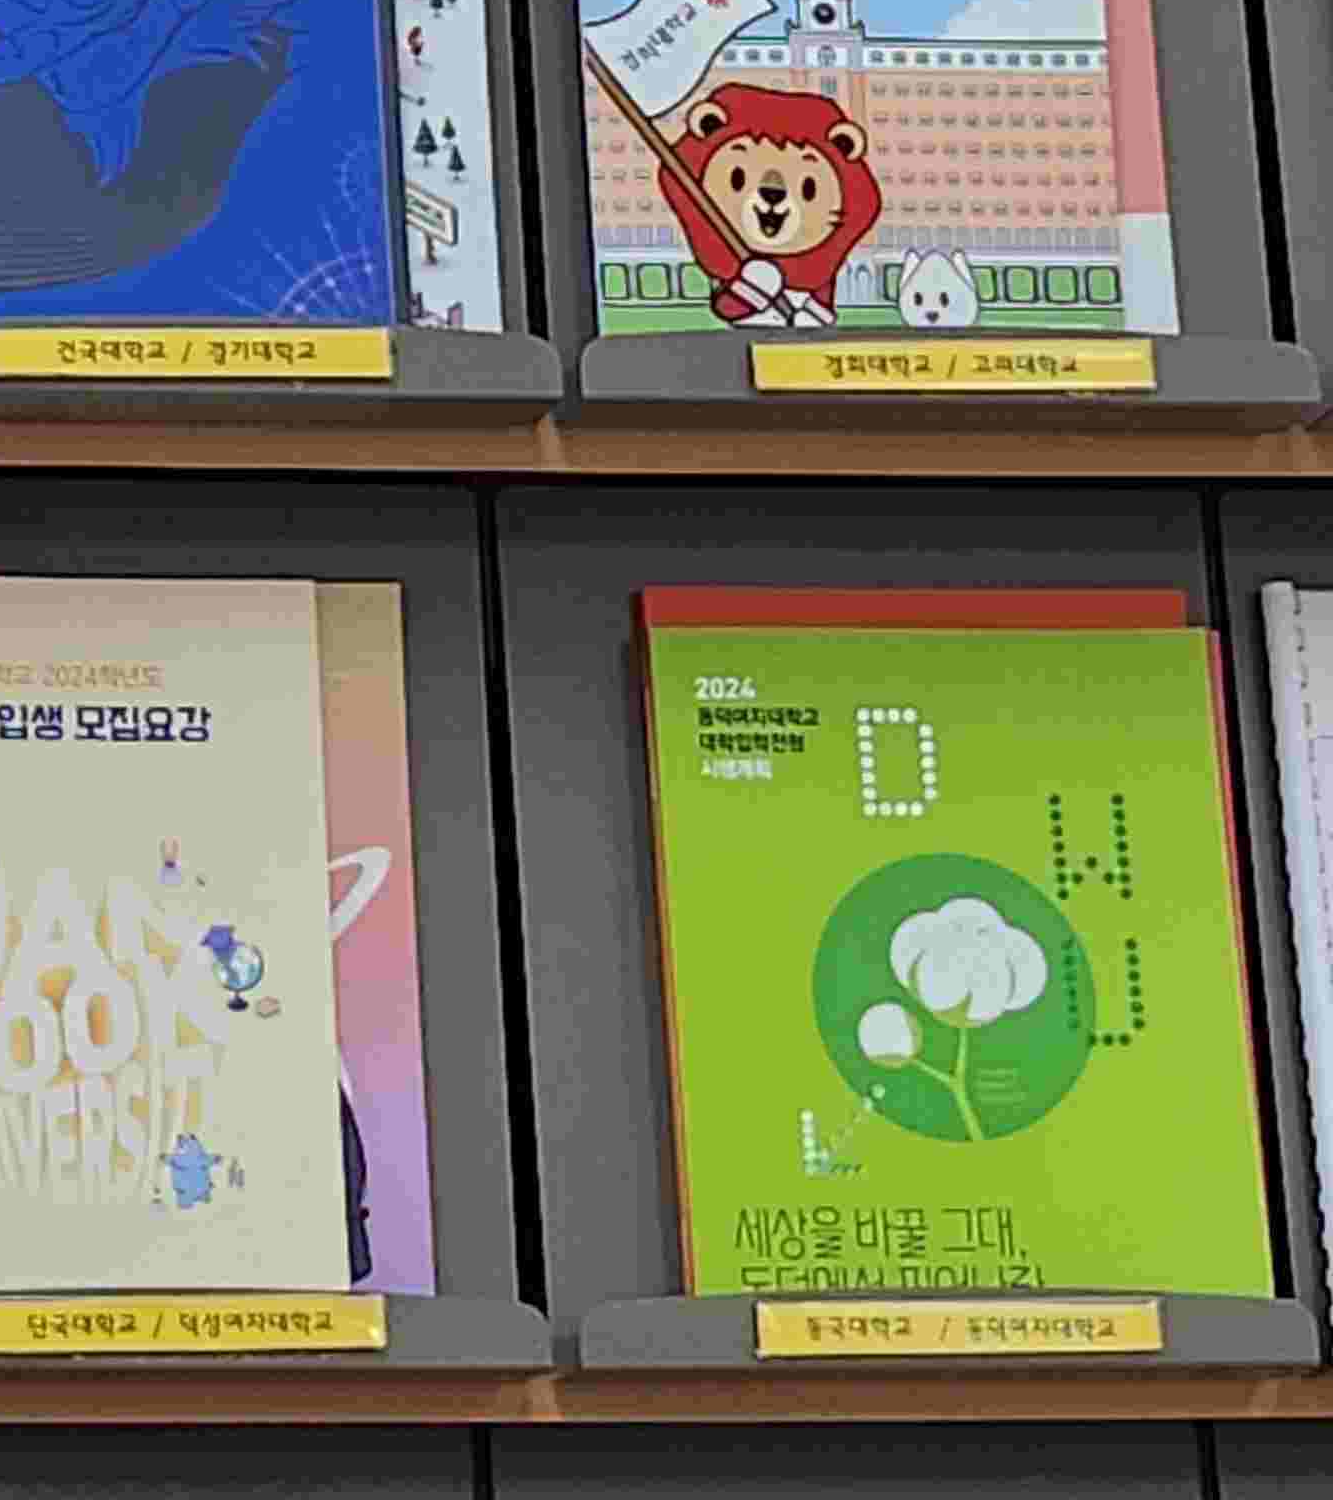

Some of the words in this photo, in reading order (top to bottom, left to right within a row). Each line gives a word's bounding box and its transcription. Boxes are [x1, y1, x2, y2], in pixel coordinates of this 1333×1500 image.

[694, 675, 756, 700] 2024
[73, 704, 212, 743] 모집요강
[734, 1205, 846, 1261] 세상을
[853, 1206, 930, 1260] 바꿀
[940, 1206, 1027, 1261] 그대,
